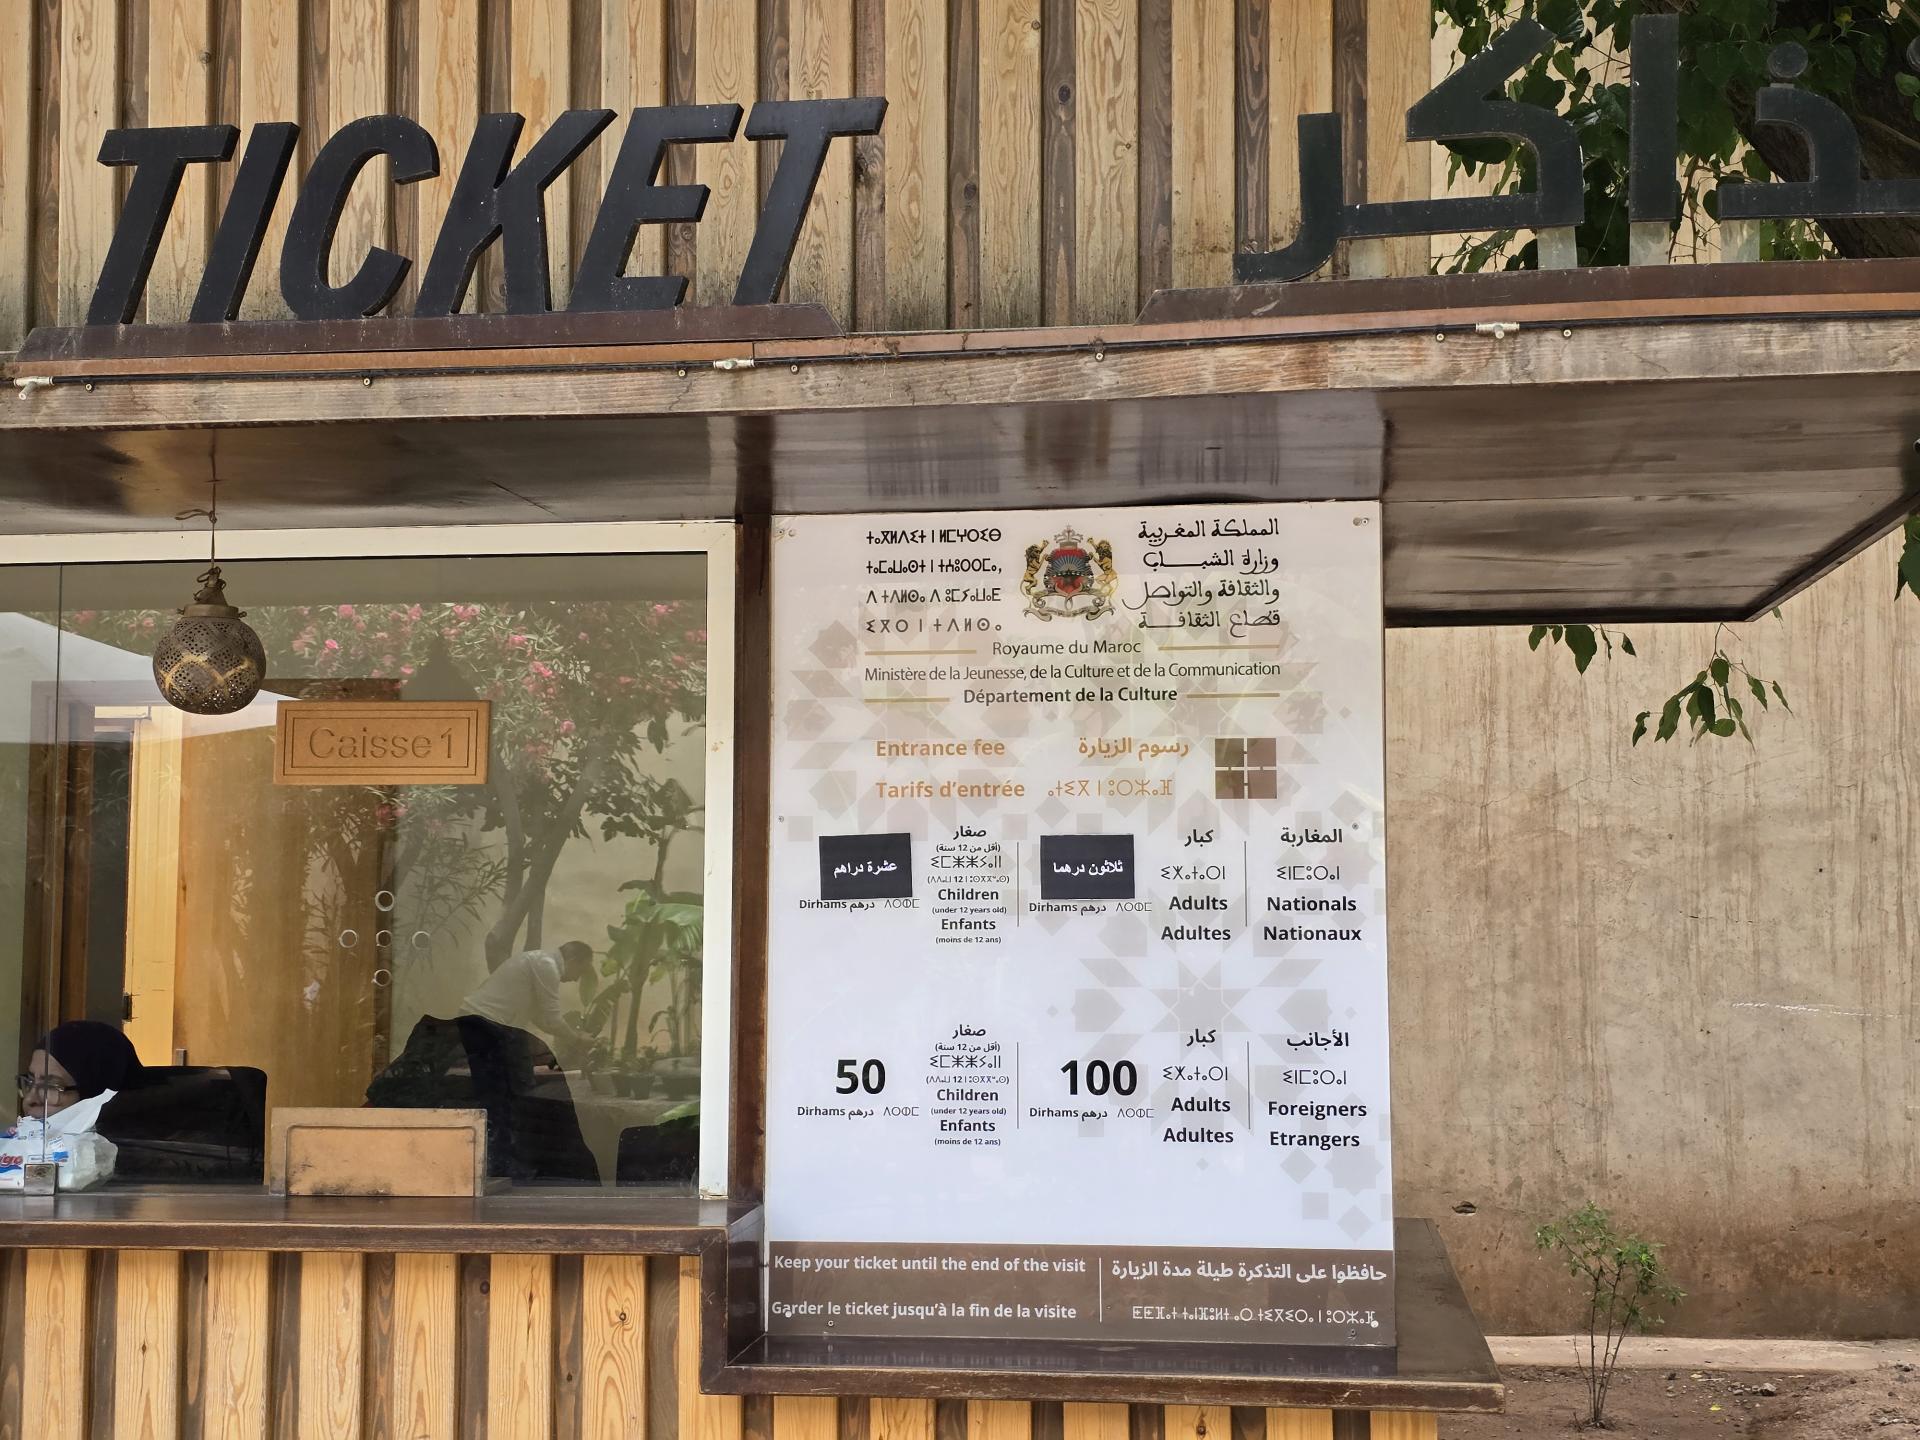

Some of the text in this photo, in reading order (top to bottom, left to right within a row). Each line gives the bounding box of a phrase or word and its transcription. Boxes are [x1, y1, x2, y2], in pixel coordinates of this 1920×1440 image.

[1234, 14, 1920, 284] ذاكر
[87, 97, 888, 325] TICKET
[1137, 518, 1279, 547] المملكة المغربية
[1239, 548, 1279, 575] وزارة
[1121, 577, 1280, 610] والثقافة والتواصل
[992, 640, 1141, 658] Royaume du Maroc
[865, 662, 1281, 681] Ministère de la Jeunesse, de la Culture et de la Communication
[963, 686, 1177, 706] Département de la Culture
[309, 727, 453, 759] Caisse 1
[876, 738, 1005, 757] Entrance fee
[1078, 737, 1189, 761] رسوم الزيارة
[875, 779, 1025, 798] Tarifs d’entrée
[953, 825, 986, 840] صغار
[1184, 829, 1214, 847] كبار
[1280, 827, 1343, 847] المغاربة
[833, 859, 898, 878] عشرة دراهم
[1053, 859, 1123, 876] ثلاثون درهما
[953, 875, 963, 883] 12
[937, 888, 999, 901] Children
[1168, 895, 1228, 910] Adults
[800, 900, 847, 909] Dirhams
[849, 900, 875, 912] درهم
[932, 906, 1007, 915] (under 12 years old)
[1029, 902, 1078, 912] Dirhams
[1080, 903, 1106, 916] درهم
[1267, 896, 1357, 911] Nationals
[941, 918, 996, 930] Enfants
[935, 936, 962, 944] (moins
[985, 936, 1002, 944] ans)
[1161, 925, 1231, 941] Adultes
[1263, 926, 1362, 941] Nationaux
[952, 1024, 986, 1039] صغار
[1187, 1029, 1217, 1047] كبار
[1286, 1029, 1349, 1051] الأجانب
[836, 1059, 886, 1095] 50
[953, 1075, 963, 1083] 12
[1060, 1060, 1137, 1096] 100
[936, 1089, 999, 1102] Children
[797, 1106, 846, 1117] Dirhams
[931, 1107, 957, 1116] (under
[991, 1107, 1007, 1116] old)
[1171, 1097, 1231, 1112] Adults
[1268, 1101, 1367, 1120] Foreigners
[848, 1108, 874, 1120] درهم
[1029, 1108, 1079, 1118] Dirhams
[1081, 1109, 1108, 1122] درهم
[940, 1119, 996, 1132] Enfants
[934, 1138, 961, 1146] (moins
[984, 1138, 1001, 1146] ans)
[1163, 1127, 1234, 1143] Adultes
[1270, 1131, 1360, 1150] Etrangers
[774, 1255, 1086, 1272] Keep your ticket until the end of the visit
[1111, 1260, 1387, 1284] حافظوا على التذكرة طيلة مدة الزيارة
[771, 1300, 1077, 1320] Garder le ticket jusqu’à la fin de la visite
